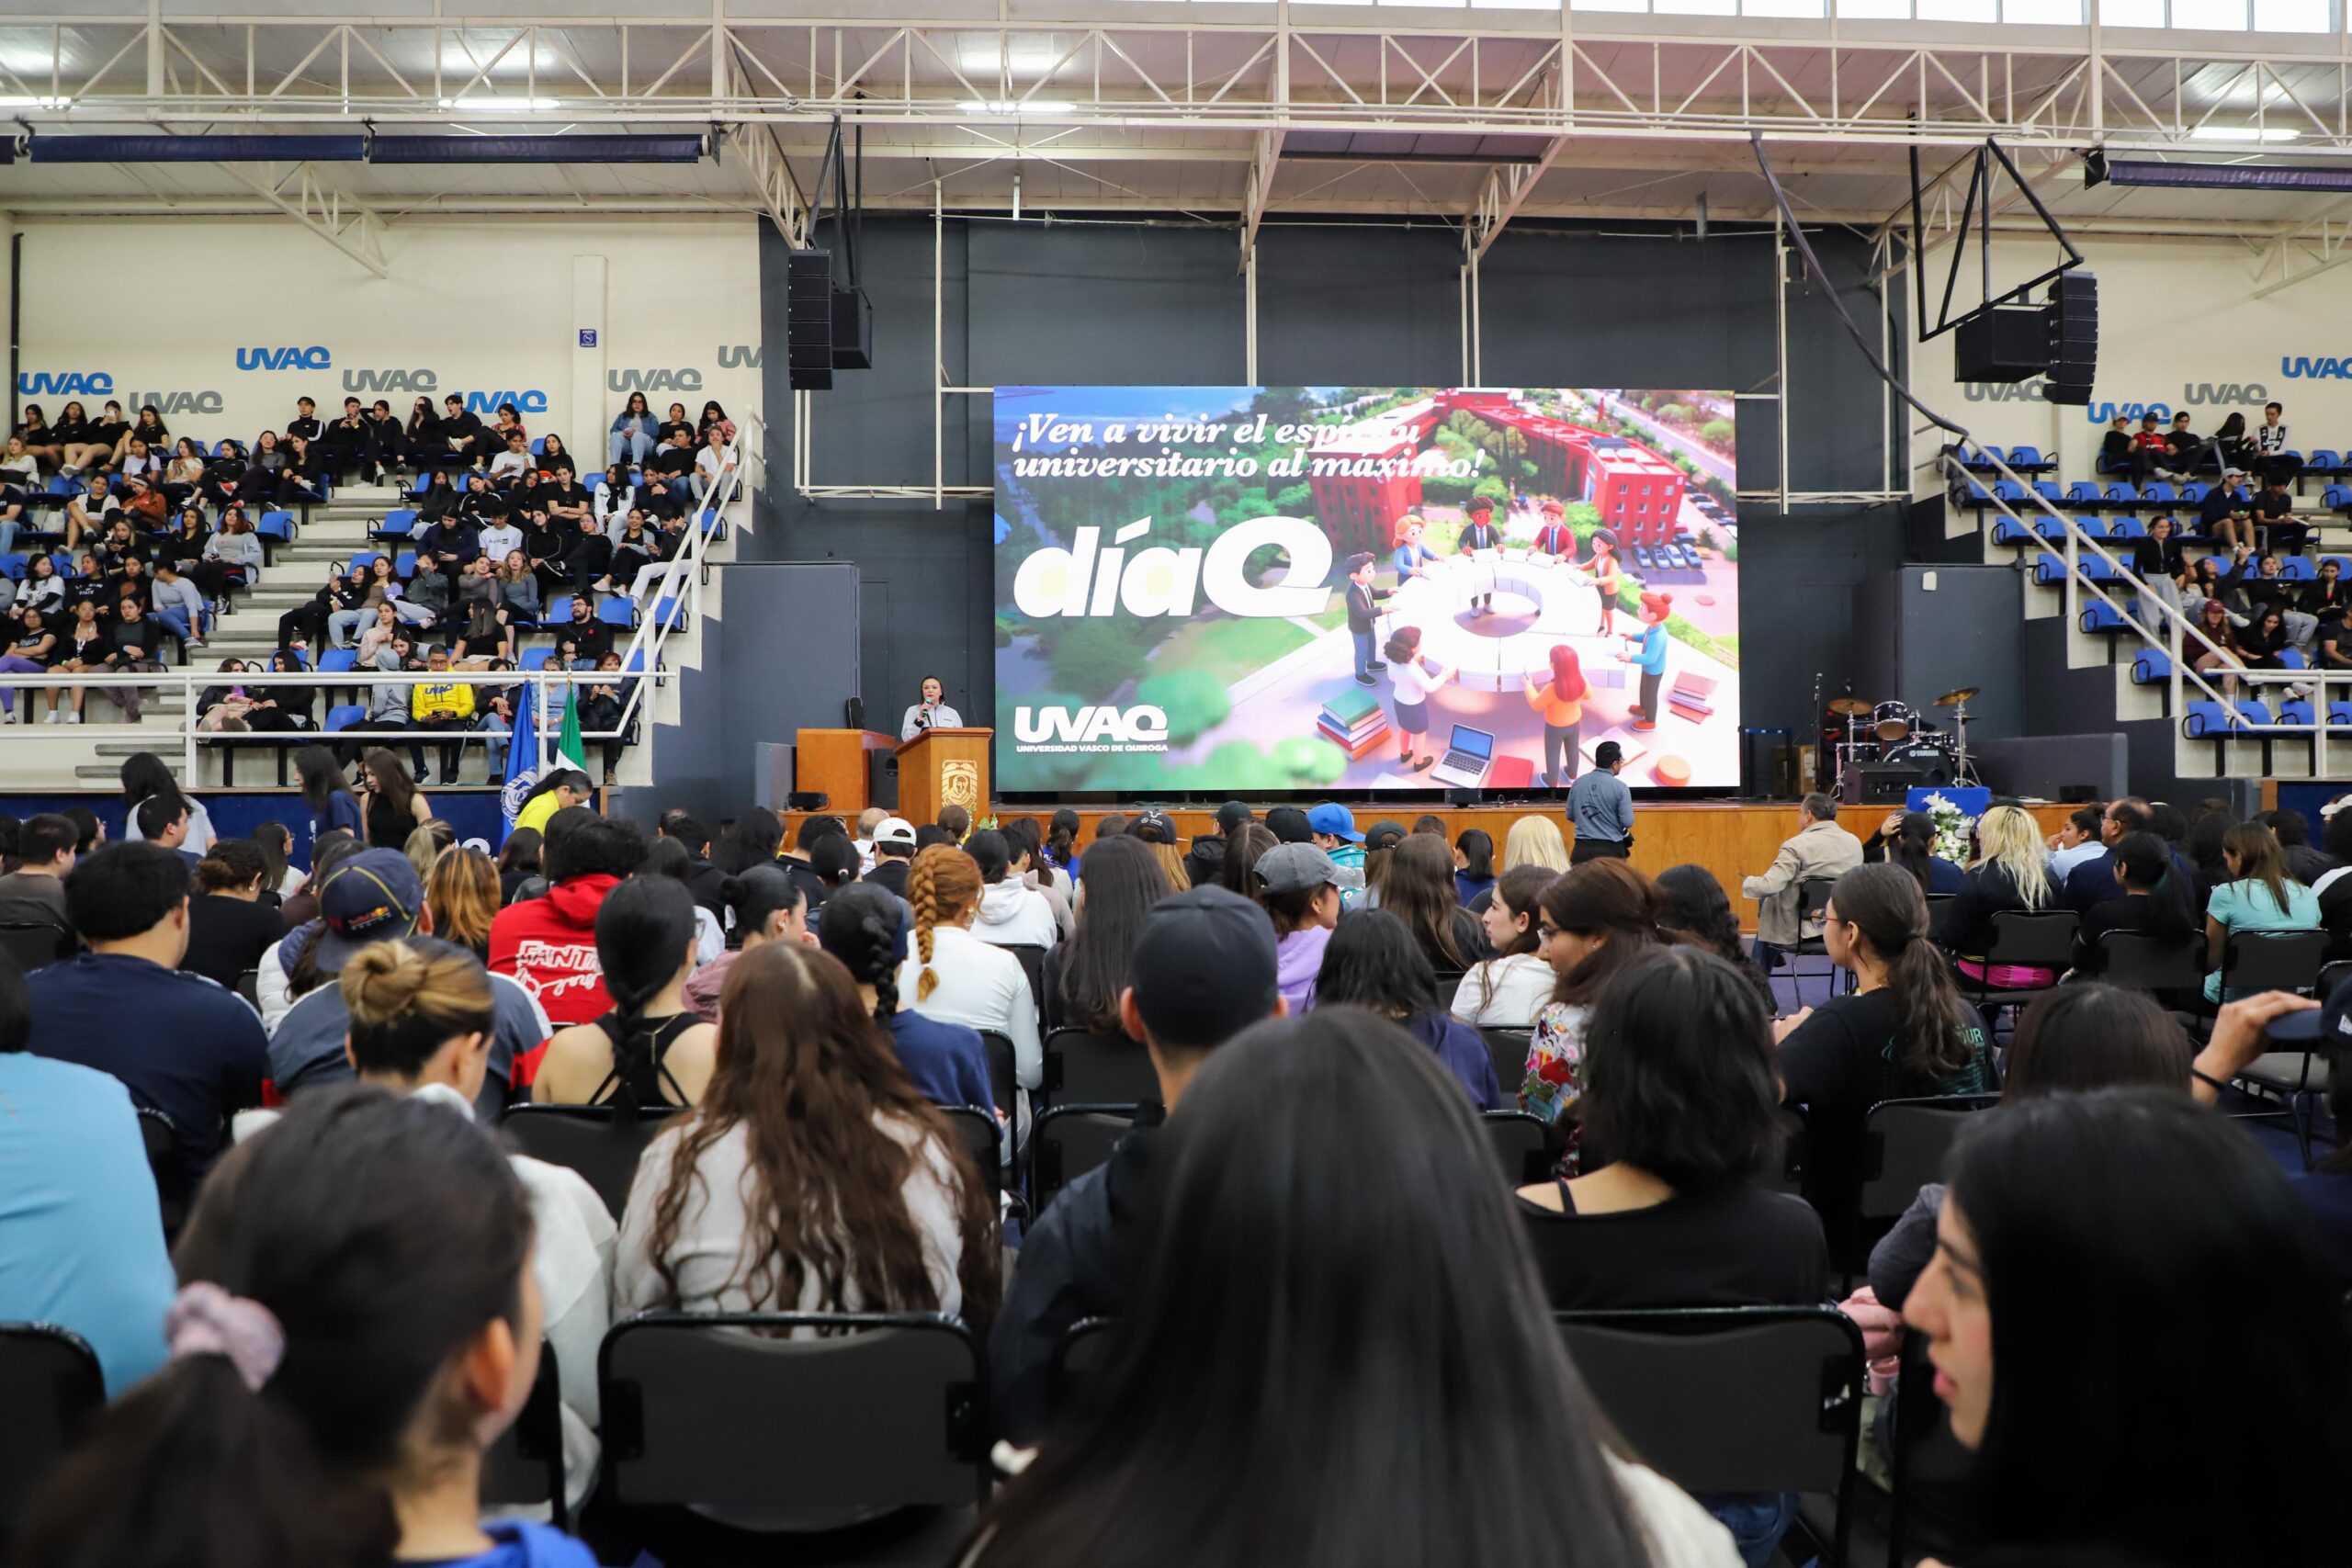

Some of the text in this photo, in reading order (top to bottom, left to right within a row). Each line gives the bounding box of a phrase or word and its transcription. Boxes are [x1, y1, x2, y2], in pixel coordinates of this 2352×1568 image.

[237, 346, 332, 370] UVAQ
[718, 345, 762, 368] UV
[18, 372, 114, 395] UVAQ
[343, 368, 437, 392] UVAQ
[607, 368, 703, 392] UVAQ
[130, 390, 223, 414] UVAQ
[455, 389, 547, 413] UVAQ
[2185, 383, 2267, 405] UVAQ
[1012, 413, 1094, 452] ¡Ven
[1102, 423, 1127, 444] a
[1136, 413, 1227, 444] vivir
[1234, 413, 1269, 444] el
[1012, 447, 1486, 479] universitario al máximo!
[1013, 515, 1333, 618] díaQ
[1014, 705, 1169, 743] UVAQ
